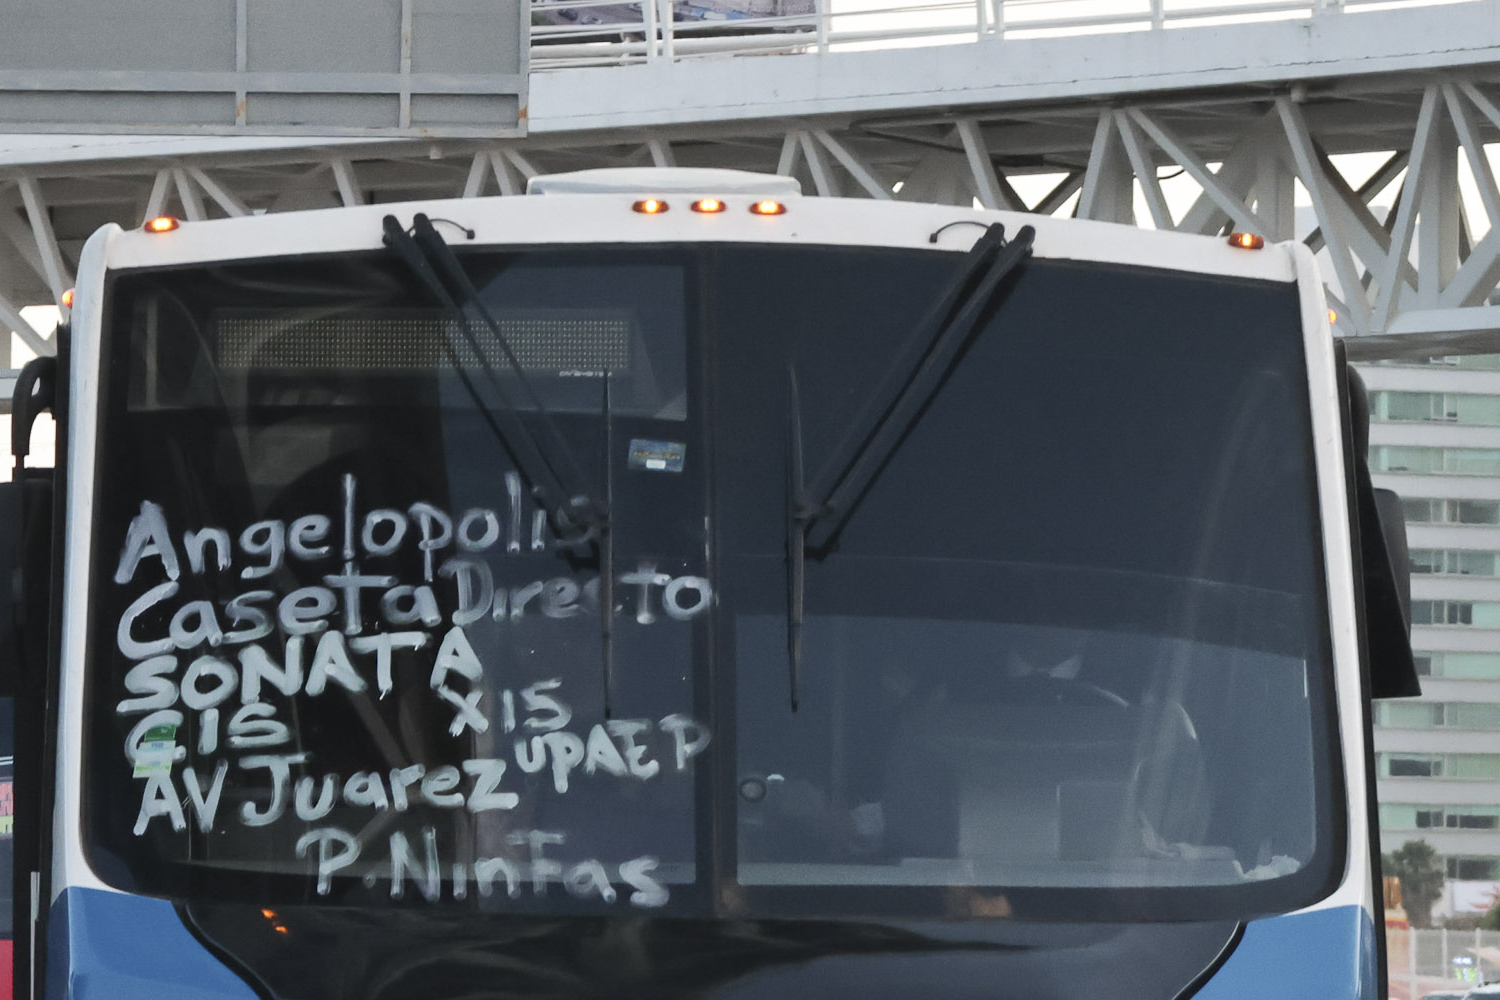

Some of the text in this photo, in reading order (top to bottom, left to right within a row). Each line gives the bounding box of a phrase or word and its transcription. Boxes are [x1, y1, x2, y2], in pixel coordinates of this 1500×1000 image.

[117, 560, 441, 660] Caseta
[116, 626, 484, 711] SONATA
[133, 752, 519, 836] AV Juarez
[515, 712, 711, 794] UPAEP
